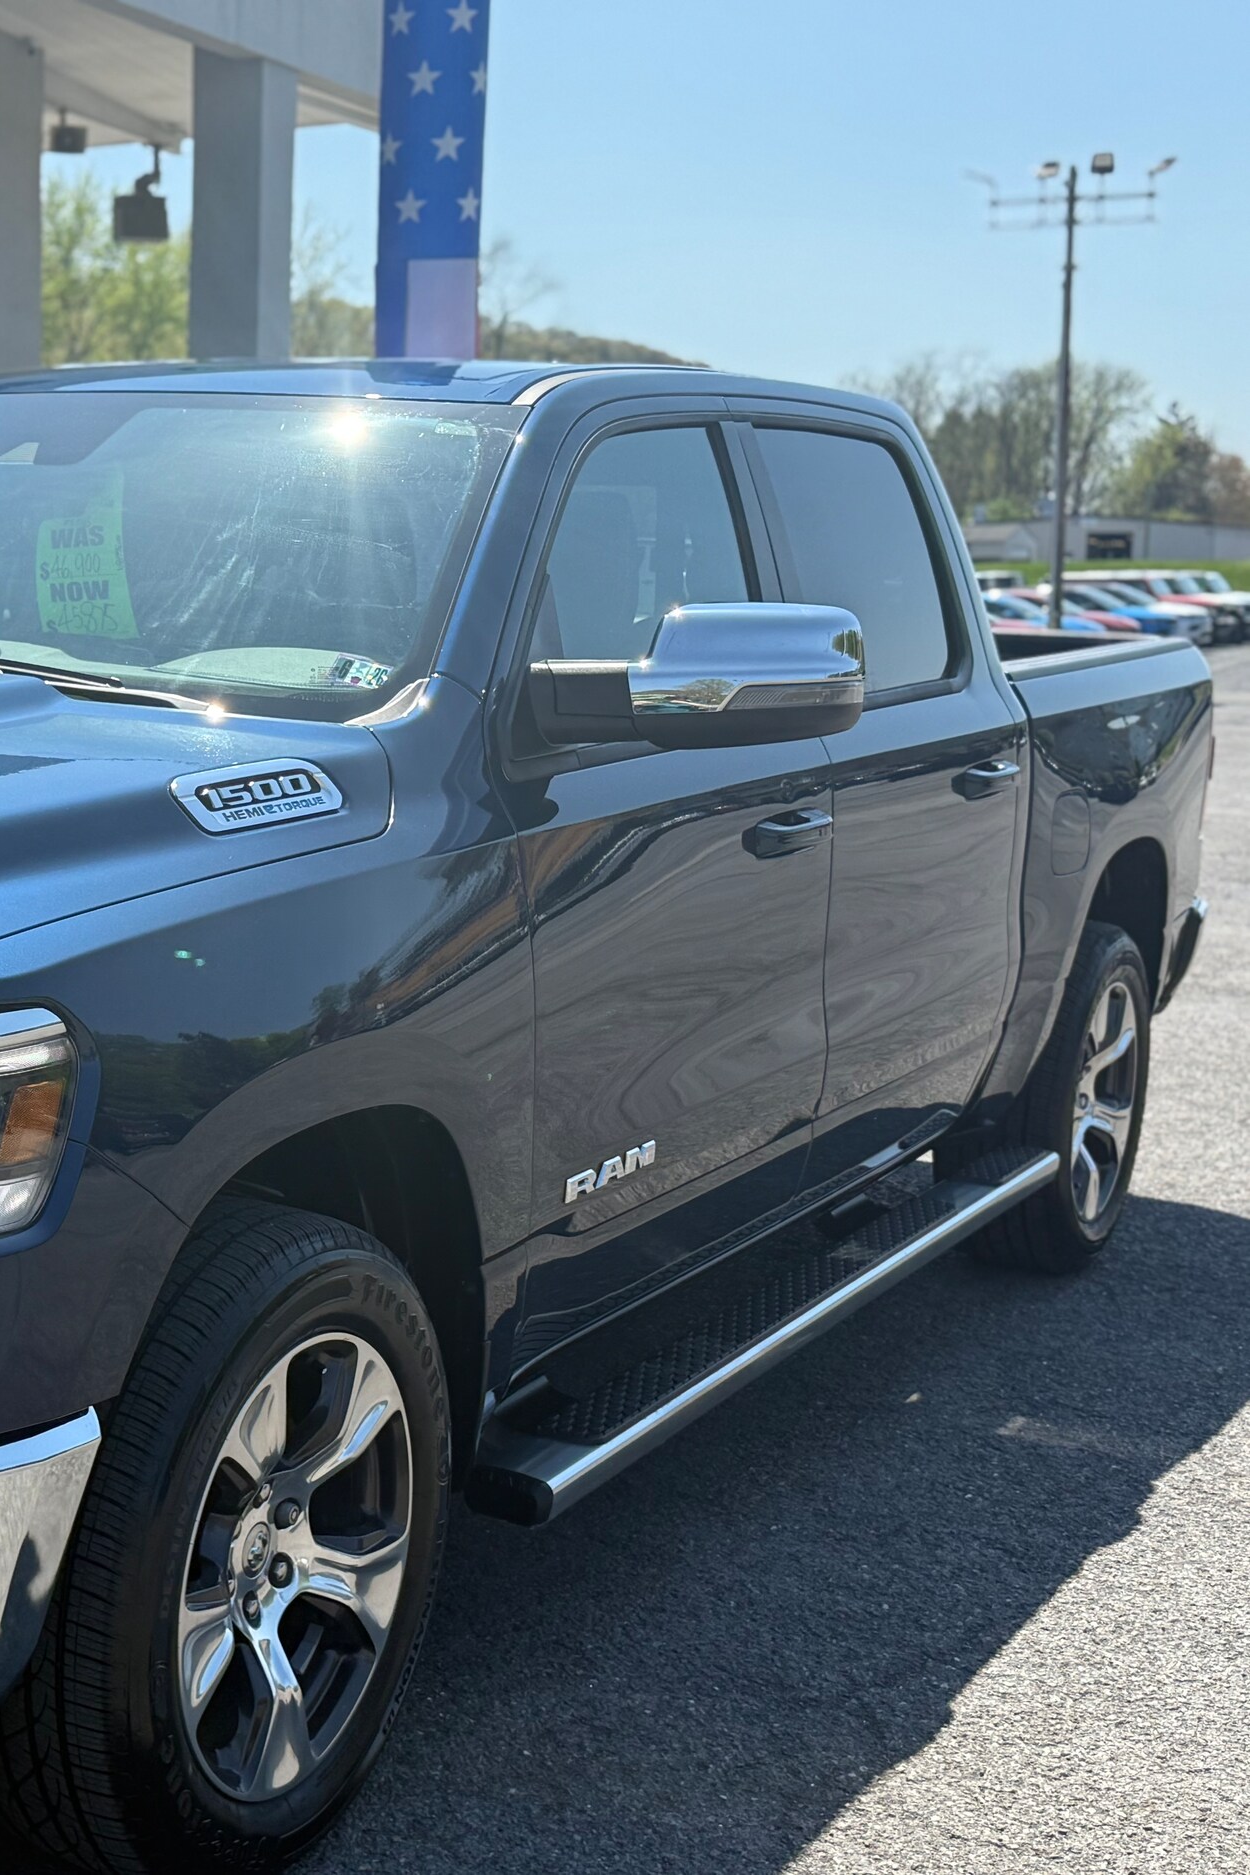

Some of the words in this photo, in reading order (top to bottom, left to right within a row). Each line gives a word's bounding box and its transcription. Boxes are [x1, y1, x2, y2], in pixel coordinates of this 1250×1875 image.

[50, 524, 104, 550] WAS
[50, 579, 110, 602] NOW
[201, 773, 312, 810] 1500
[563, 1139, 656, 1204] RAM
[360, 1272, 446, 1422] Firestone
